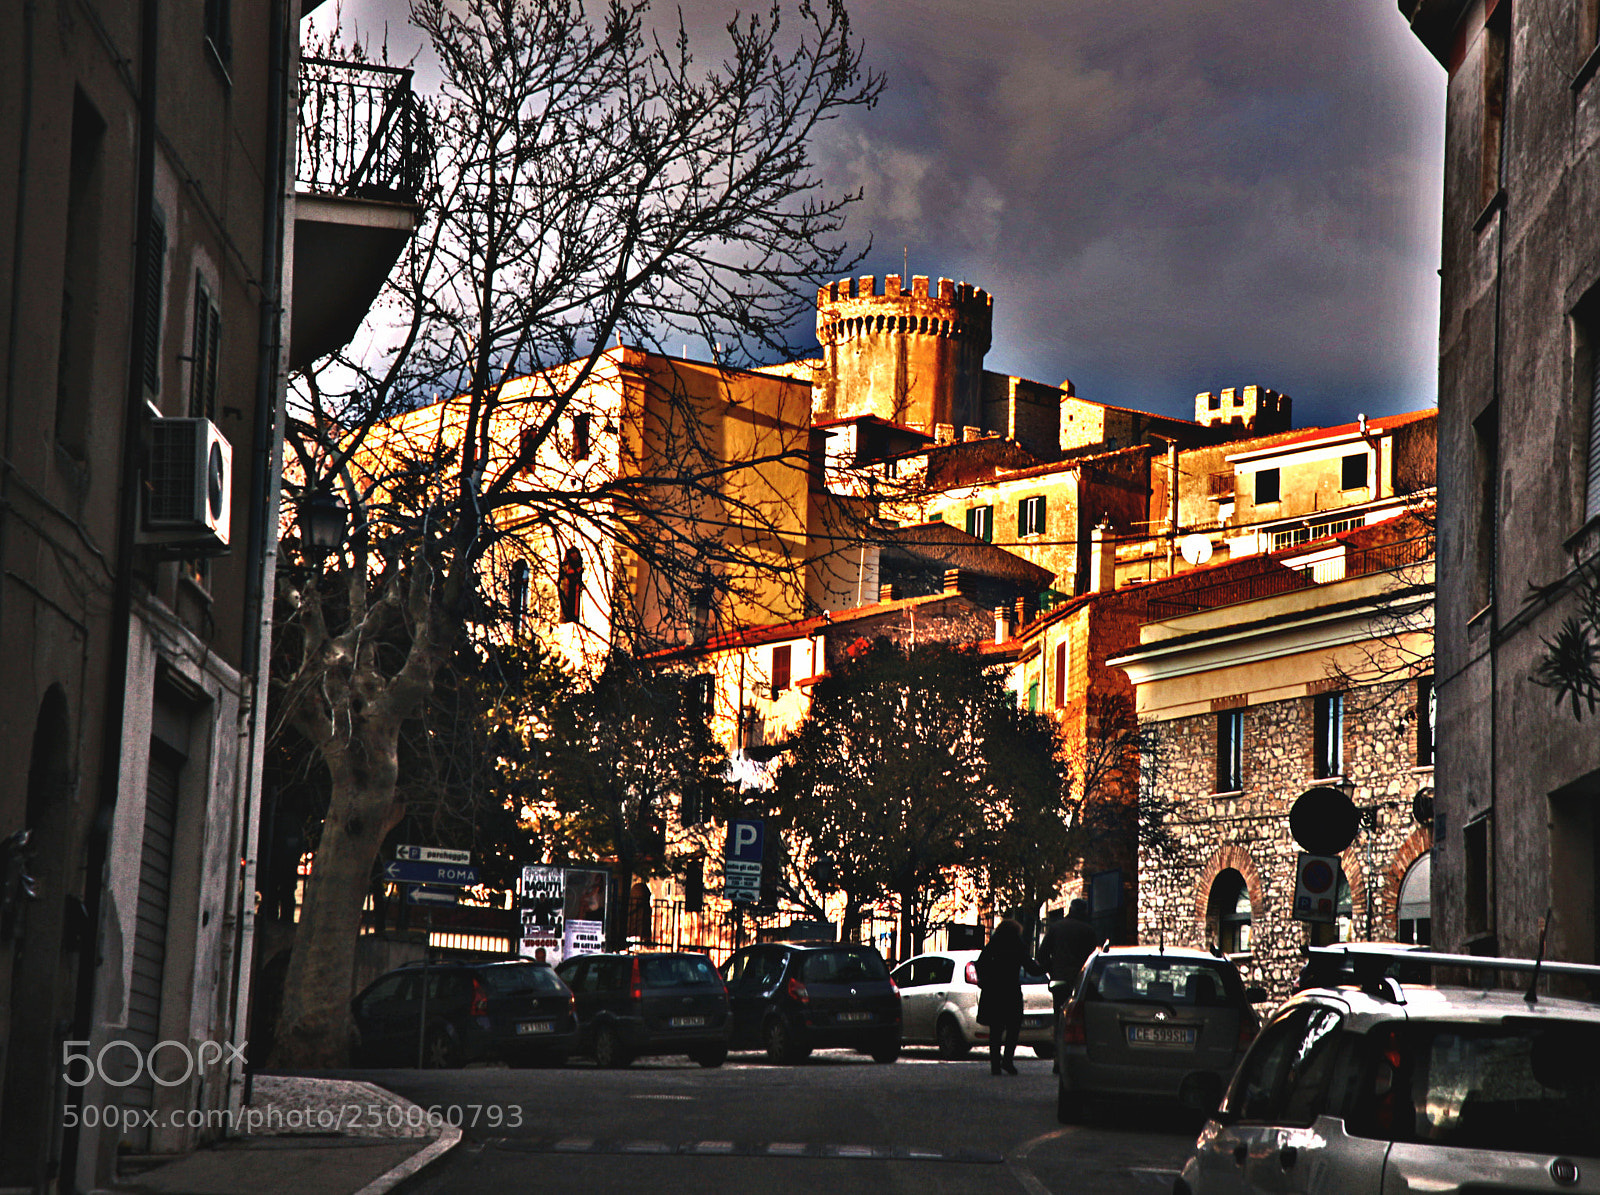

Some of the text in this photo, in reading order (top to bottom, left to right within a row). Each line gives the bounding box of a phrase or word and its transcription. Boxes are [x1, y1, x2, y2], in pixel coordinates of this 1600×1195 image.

[735, 824, 757, 855] P
[412, 849, 469, 861] P parcheggio
[437, 868, 475, 880] ROMA
[525, 881, 561, 891] BAGUTTI
[1136, 1028, 1149, 1040] CE
